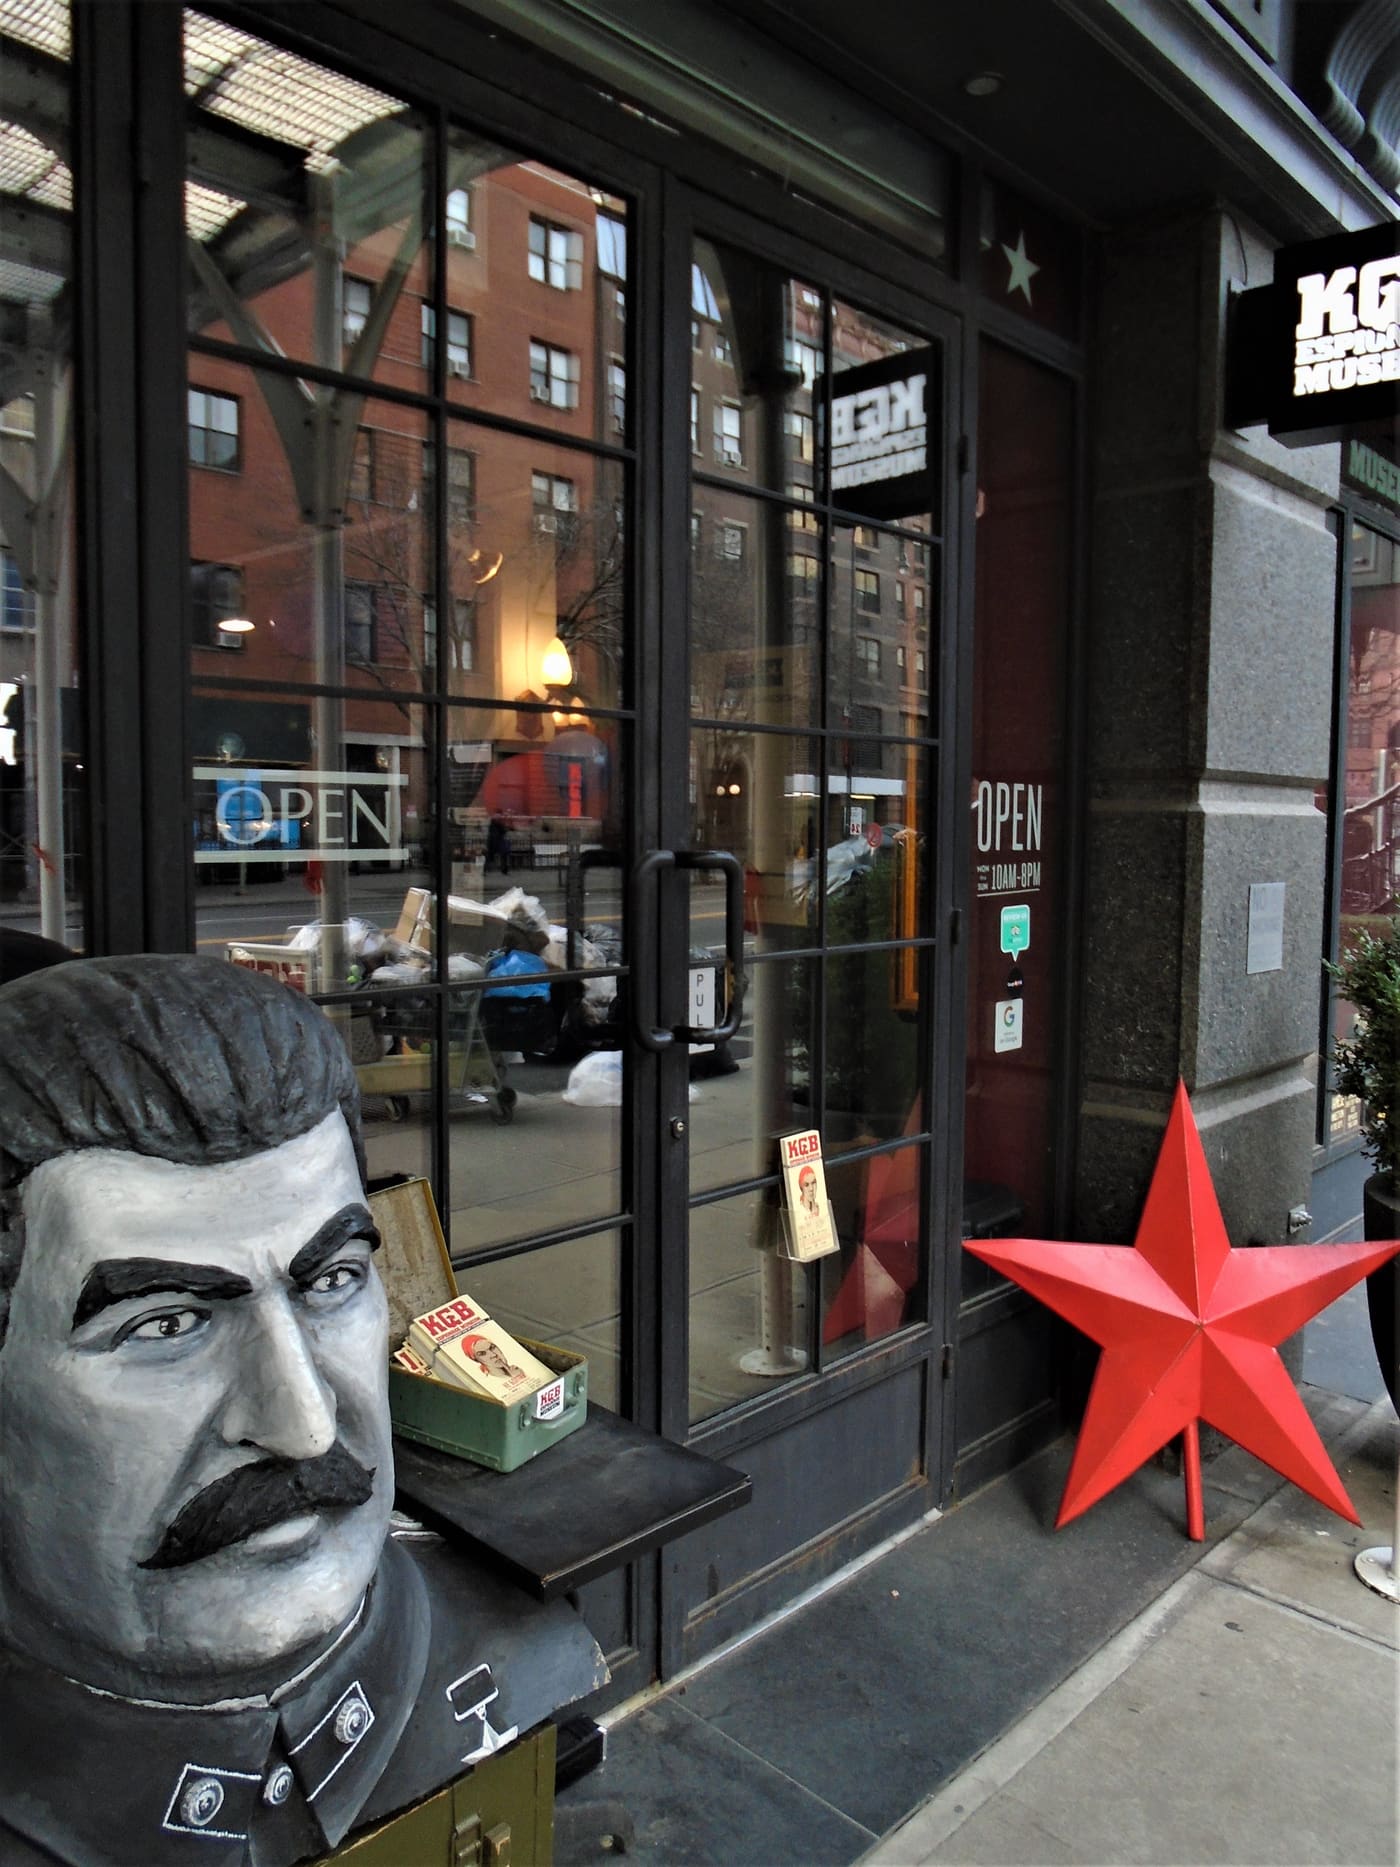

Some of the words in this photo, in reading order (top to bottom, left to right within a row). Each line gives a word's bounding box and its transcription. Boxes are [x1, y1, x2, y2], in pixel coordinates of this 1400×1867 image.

[1349, 439, 1400, 505] MUSE
[216, 786, 391, 844] OPEN
[977, 780, 1042, 852] OPEN
[992, 862, 1040, 890] 10AM-8PM
[696, 974, 704, 1027] PUL
[787, 1135, 819, 1158] KGB
[419, 1300, 476, 1336] KGB
[540, 1385, 561, 1406] KGB
